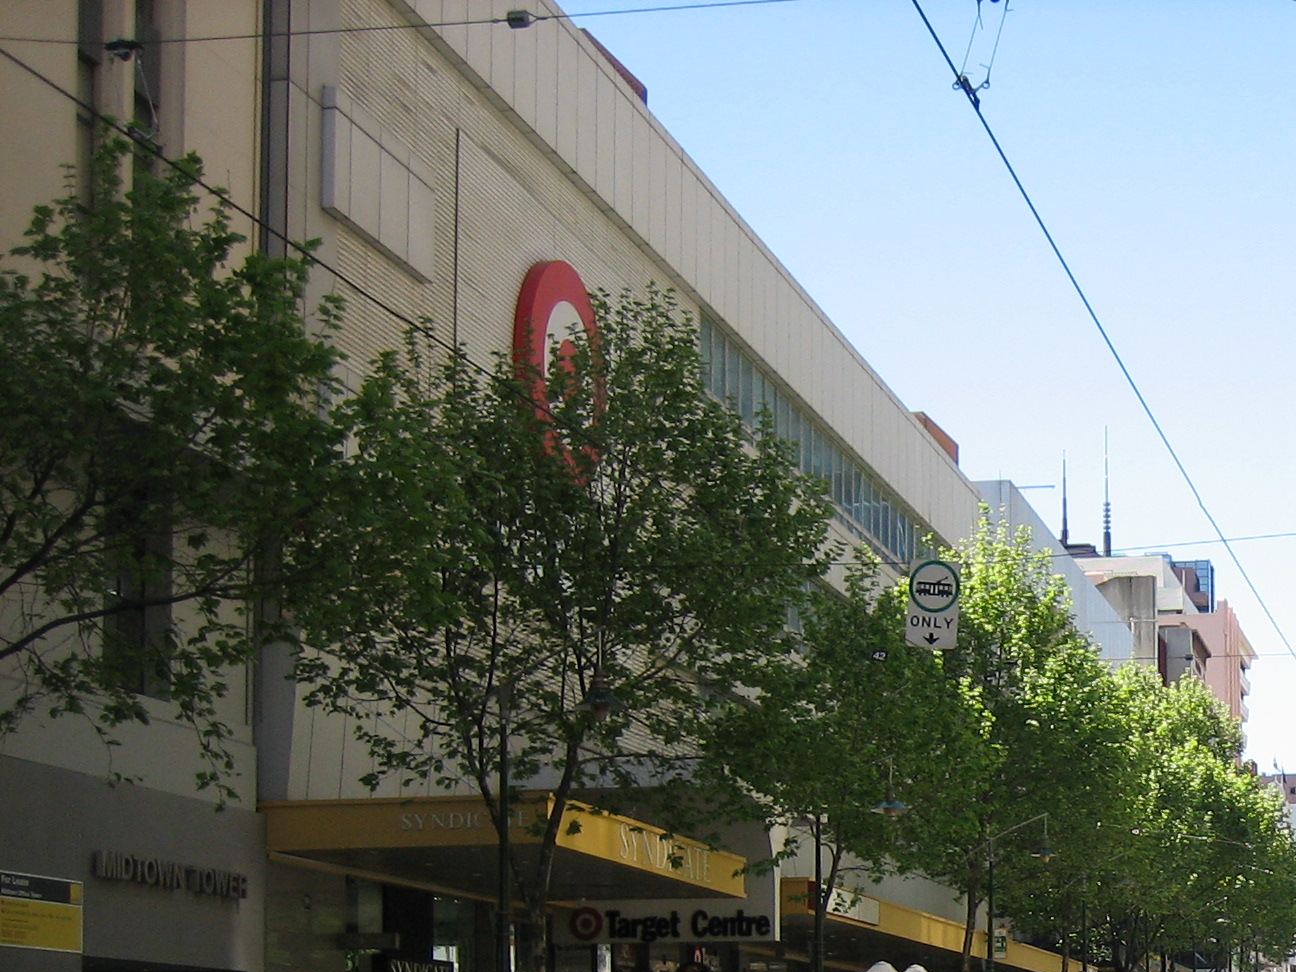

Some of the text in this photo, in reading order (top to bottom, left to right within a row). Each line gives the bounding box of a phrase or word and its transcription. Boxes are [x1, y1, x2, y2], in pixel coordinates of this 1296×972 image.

[910, 615, 954, 629] ONLY
[873, 651, 886, 661] 42
[402, 811, 529, 830] SYNDICTE
[96, 849, 248, 898] MIDTOWN TOWER
[605, 909, 771, 941] Target Centre
